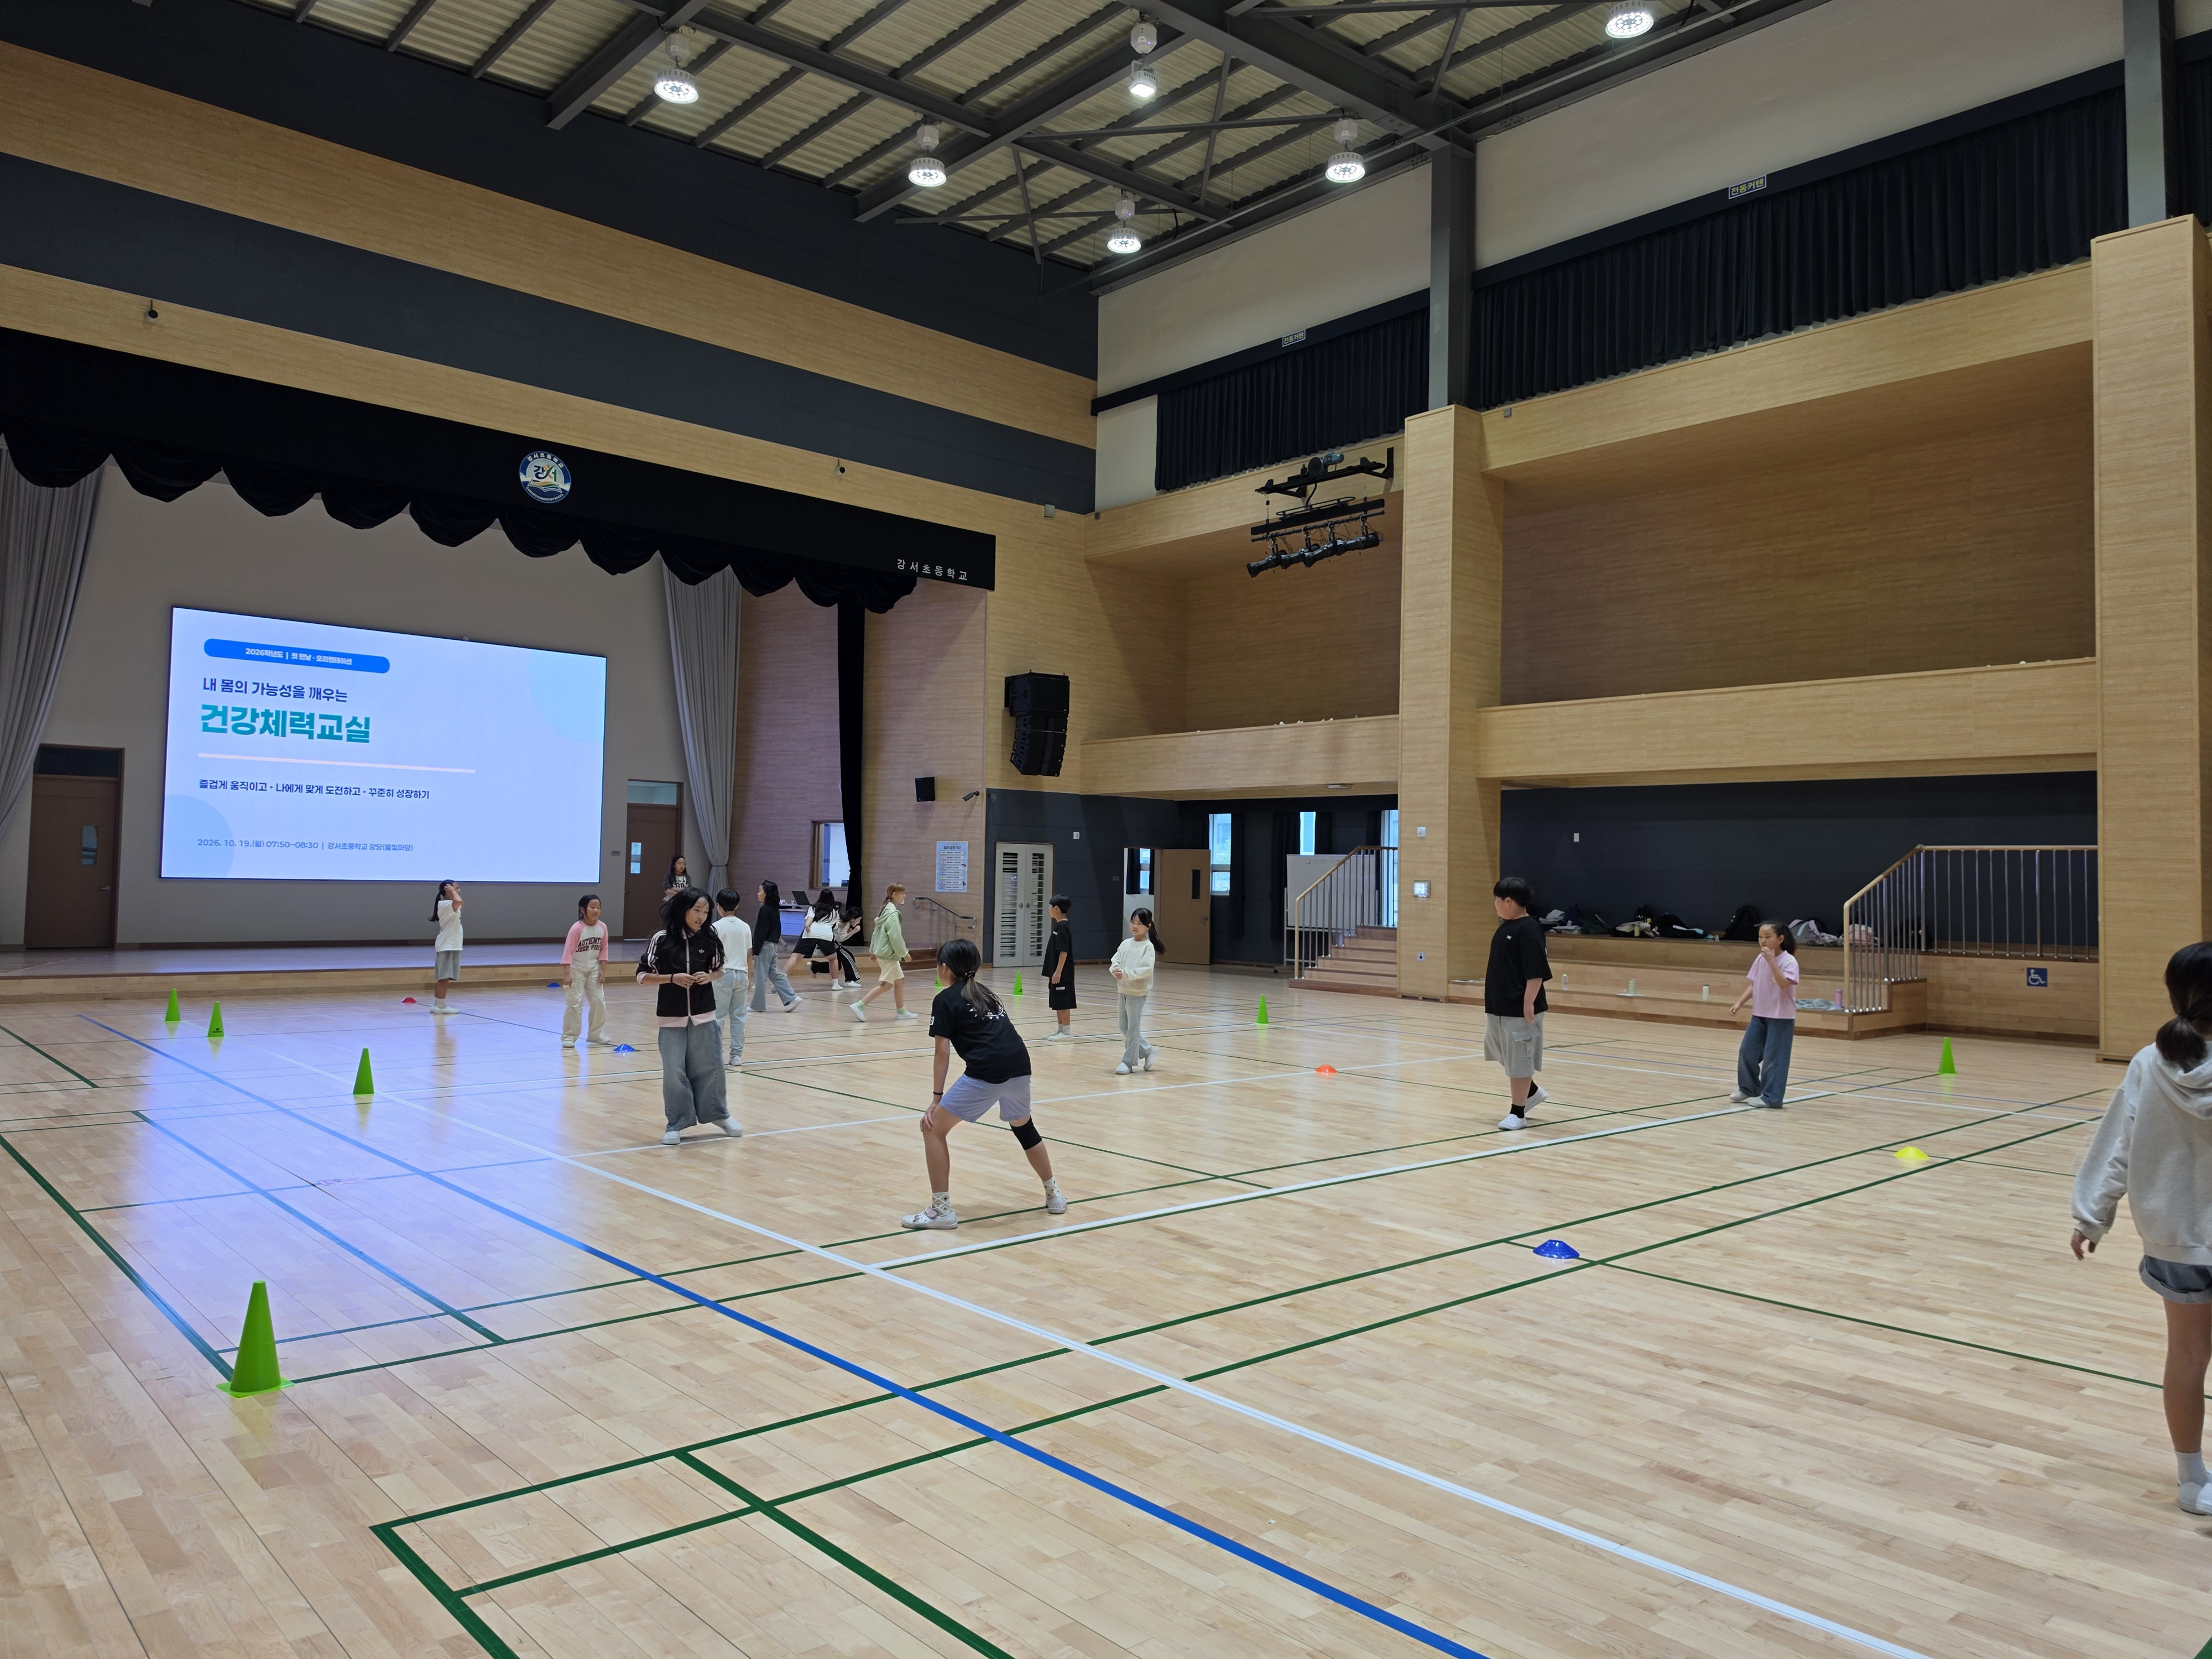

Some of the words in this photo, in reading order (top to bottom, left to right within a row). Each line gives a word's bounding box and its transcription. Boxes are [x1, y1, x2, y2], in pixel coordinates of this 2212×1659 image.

[1731, 178, 1764, 195] 전동커텐
[527, 452, 564, 468] 강서초등학교
[534, 465, 557, 482] 강서
[897, 559, 968, 581] 강서초등학교
[246, 648, 283, 658] 2026학년도
[316, 655, 352, 665] 오리엔테이션
[204, 678, 216, 691] 내
[221, 679, 247, 693] 몸의
[252, 682, 305, 698] 가능성을
[309, 687, 347, 702] 깨우는
[201, 705, 370, 743] 건강체력교실
[200, 780, 227, 789] 즐겁게
[231, 781, 267, 791] 움직이고
[276, 784, 302, 793] 나에게
[306, 785, 323, 794] 맞게
[326, 786, 360, 795] 도전하고
[369, 788, 394, 797] 꾸준히
[397, 790, 429, 799] 성장하기
